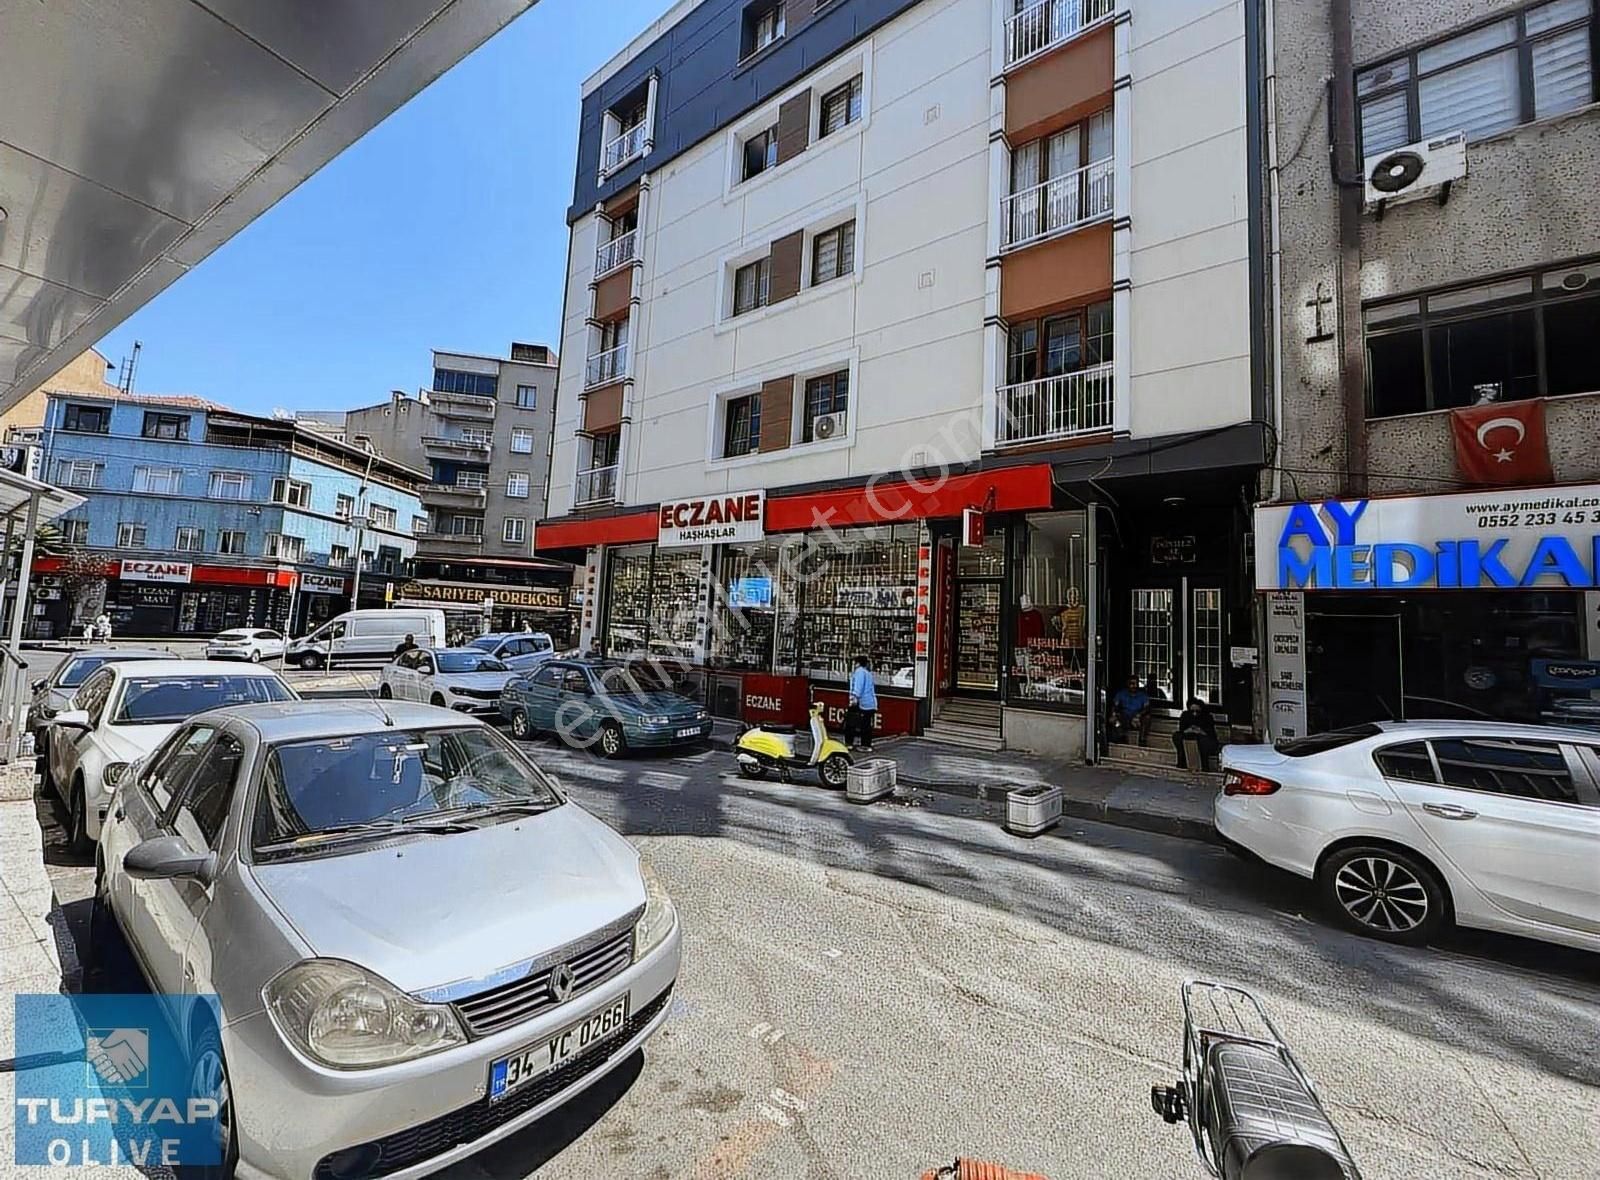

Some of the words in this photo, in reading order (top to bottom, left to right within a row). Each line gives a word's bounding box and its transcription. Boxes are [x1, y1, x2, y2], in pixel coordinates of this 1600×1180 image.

[660, 494, 761, 529] ECZANE
[1465, 497, 1600, 515] www.aymedikal.co
[1278, 500, 1370, 546] AY
[1478, 513, 1520, 528] 0552
[1524, 512, 1557, 526] 233
[1562, 510, 1586, 524] 45
[679, 527, 736, 541] HAŞHAŞLAR
[123, 562, 188, 576] ECZANE
[304, 574, 343, 588] ECZANE
[424, 586, 485, 602] SARIYER
[745, 694, 782, 711] ECZANE
[508, 1052, 533, 1085] 34
[550, 1031, 573, 1063] YC
[580, 1004, 624, 1046] 0266
